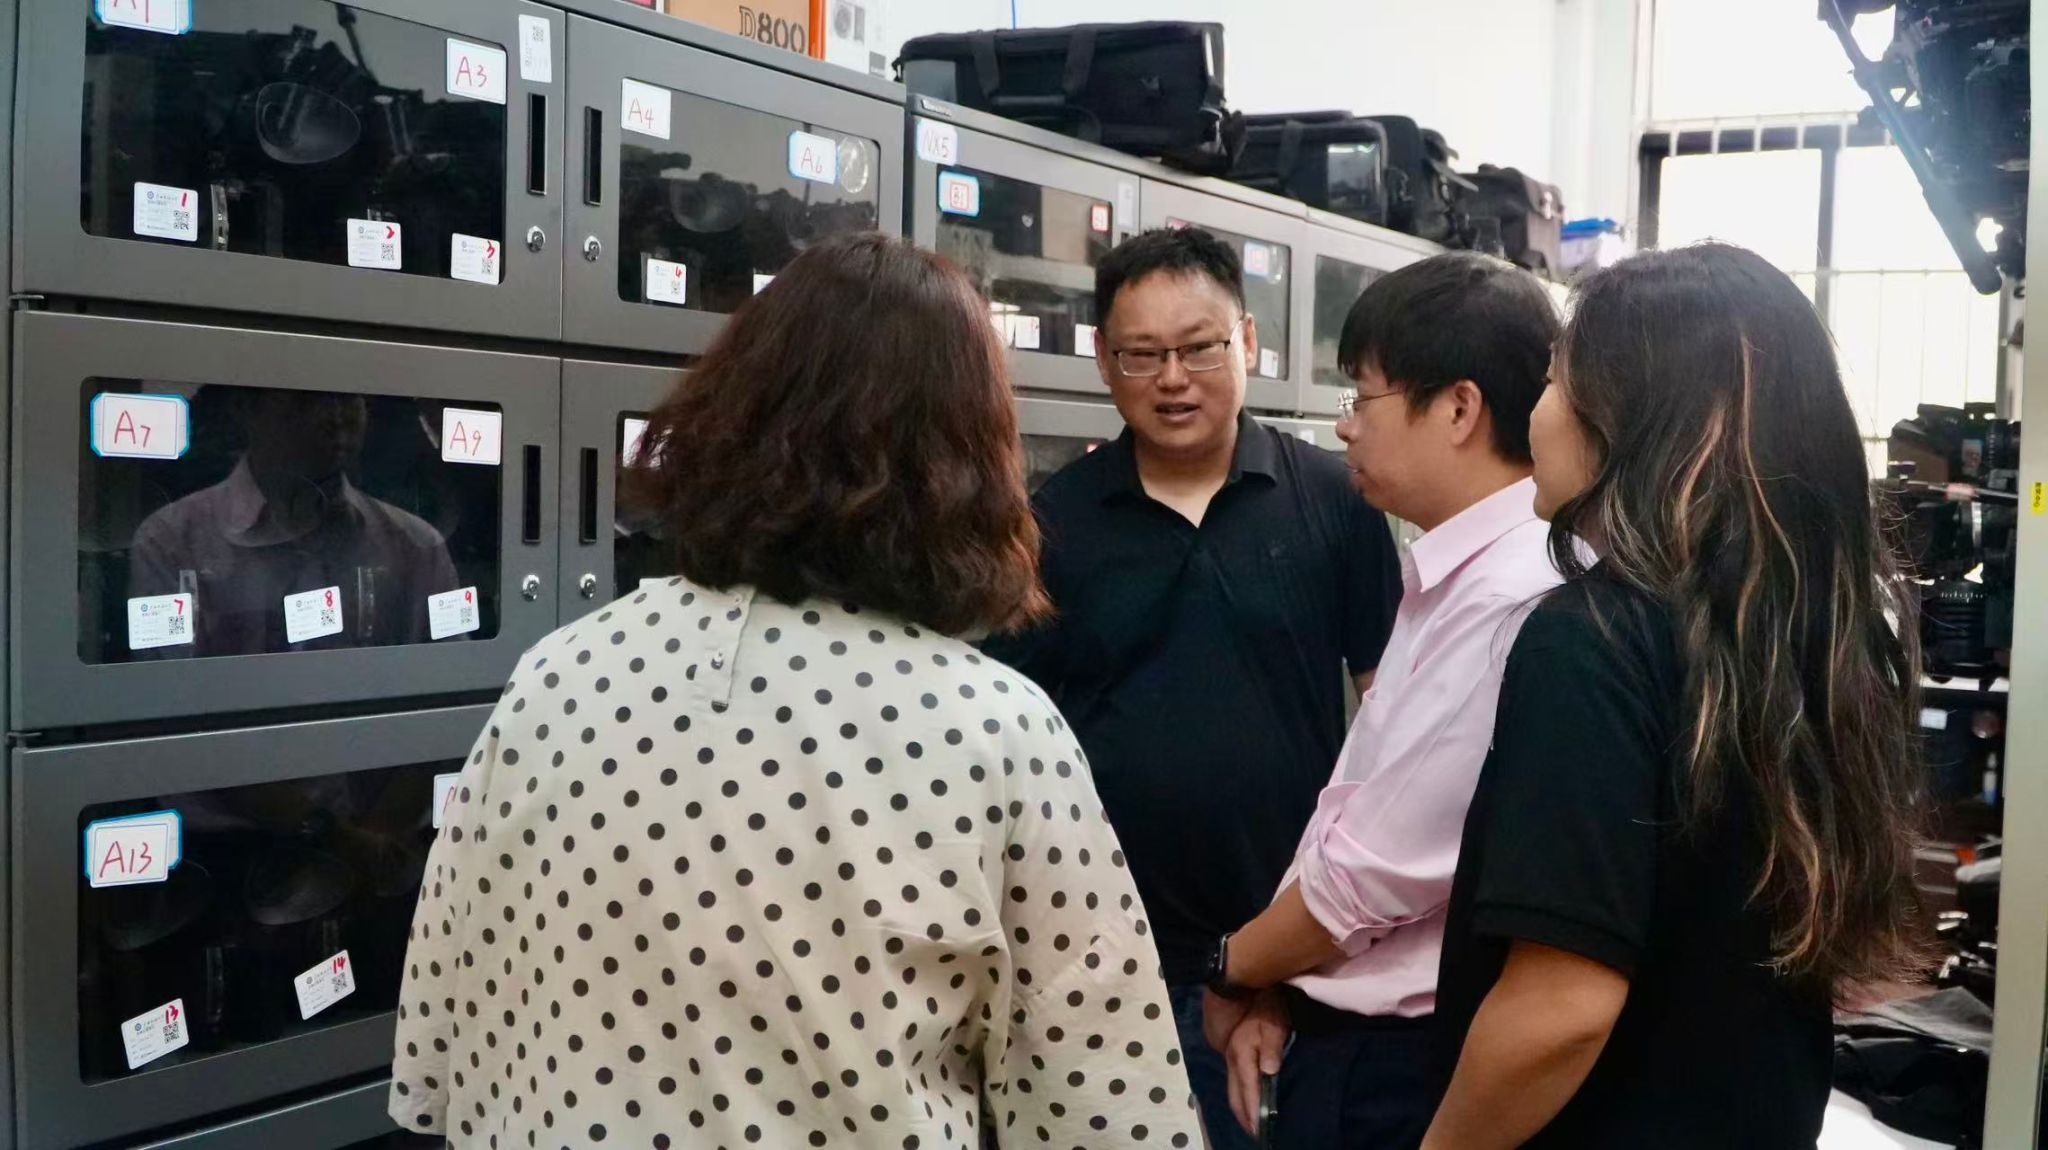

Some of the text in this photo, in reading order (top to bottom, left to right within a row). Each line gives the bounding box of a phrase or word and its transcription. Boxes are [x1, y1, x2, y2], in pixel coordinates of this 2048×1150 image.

[738, 4, 806, 54] D800
[455, 56, 488, 88] A3
[628, 96, 655, 129] A4
[181, 192, 187, 208] 1
[486, 240, 496, 259] 3
[113, 410, 151, 449] A7
[449, 420, 482, 457] A9
[174, 599, 184, 615] 7
[325, 590, 333, 607] 8
[465, 590, 472, 605] 9
[99, 840, 152, 878] A13
[333, 956, 346, 974] 14
[165, 1005, 179, 1024] 13
